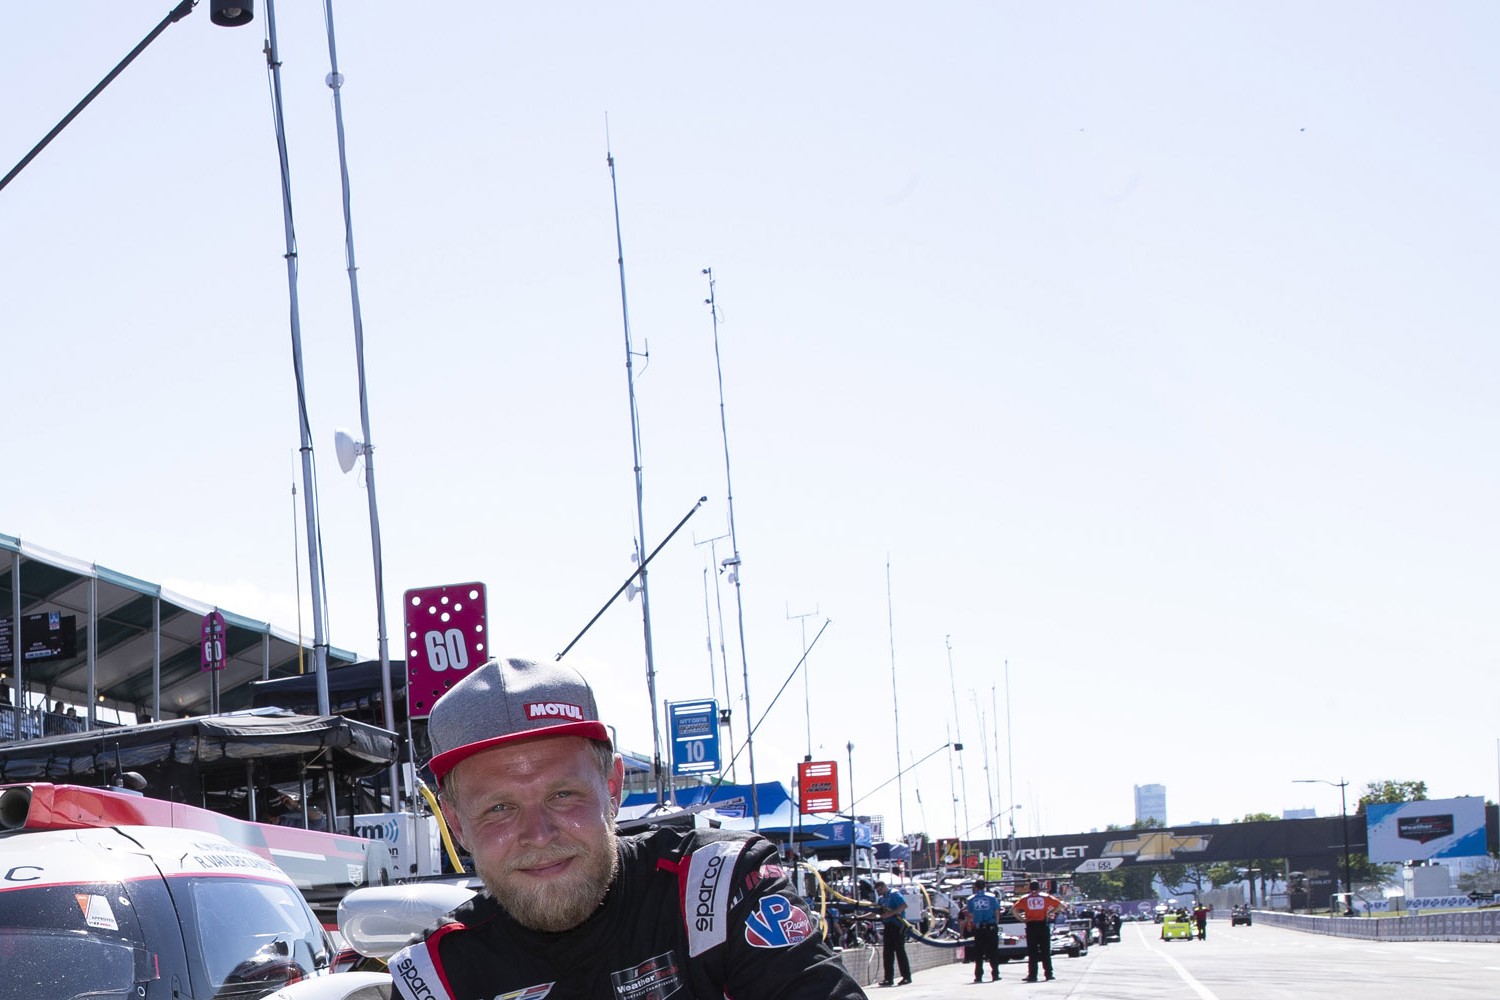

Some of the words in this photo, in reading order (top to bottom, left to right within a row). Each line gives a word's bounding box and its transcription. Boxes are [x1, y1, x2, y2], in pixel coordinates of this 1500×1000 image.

[425, 628, 469, 672] 60
[530, 703, 583, 720] MOTUL
[685, 740, 705, 762] 10
[979, 844, 1090, 864] HEVROLET
[696, 855, 726, 932] sparco
[746, 894, 791, 946] VP
[783, 917, 810, 937] Racing
